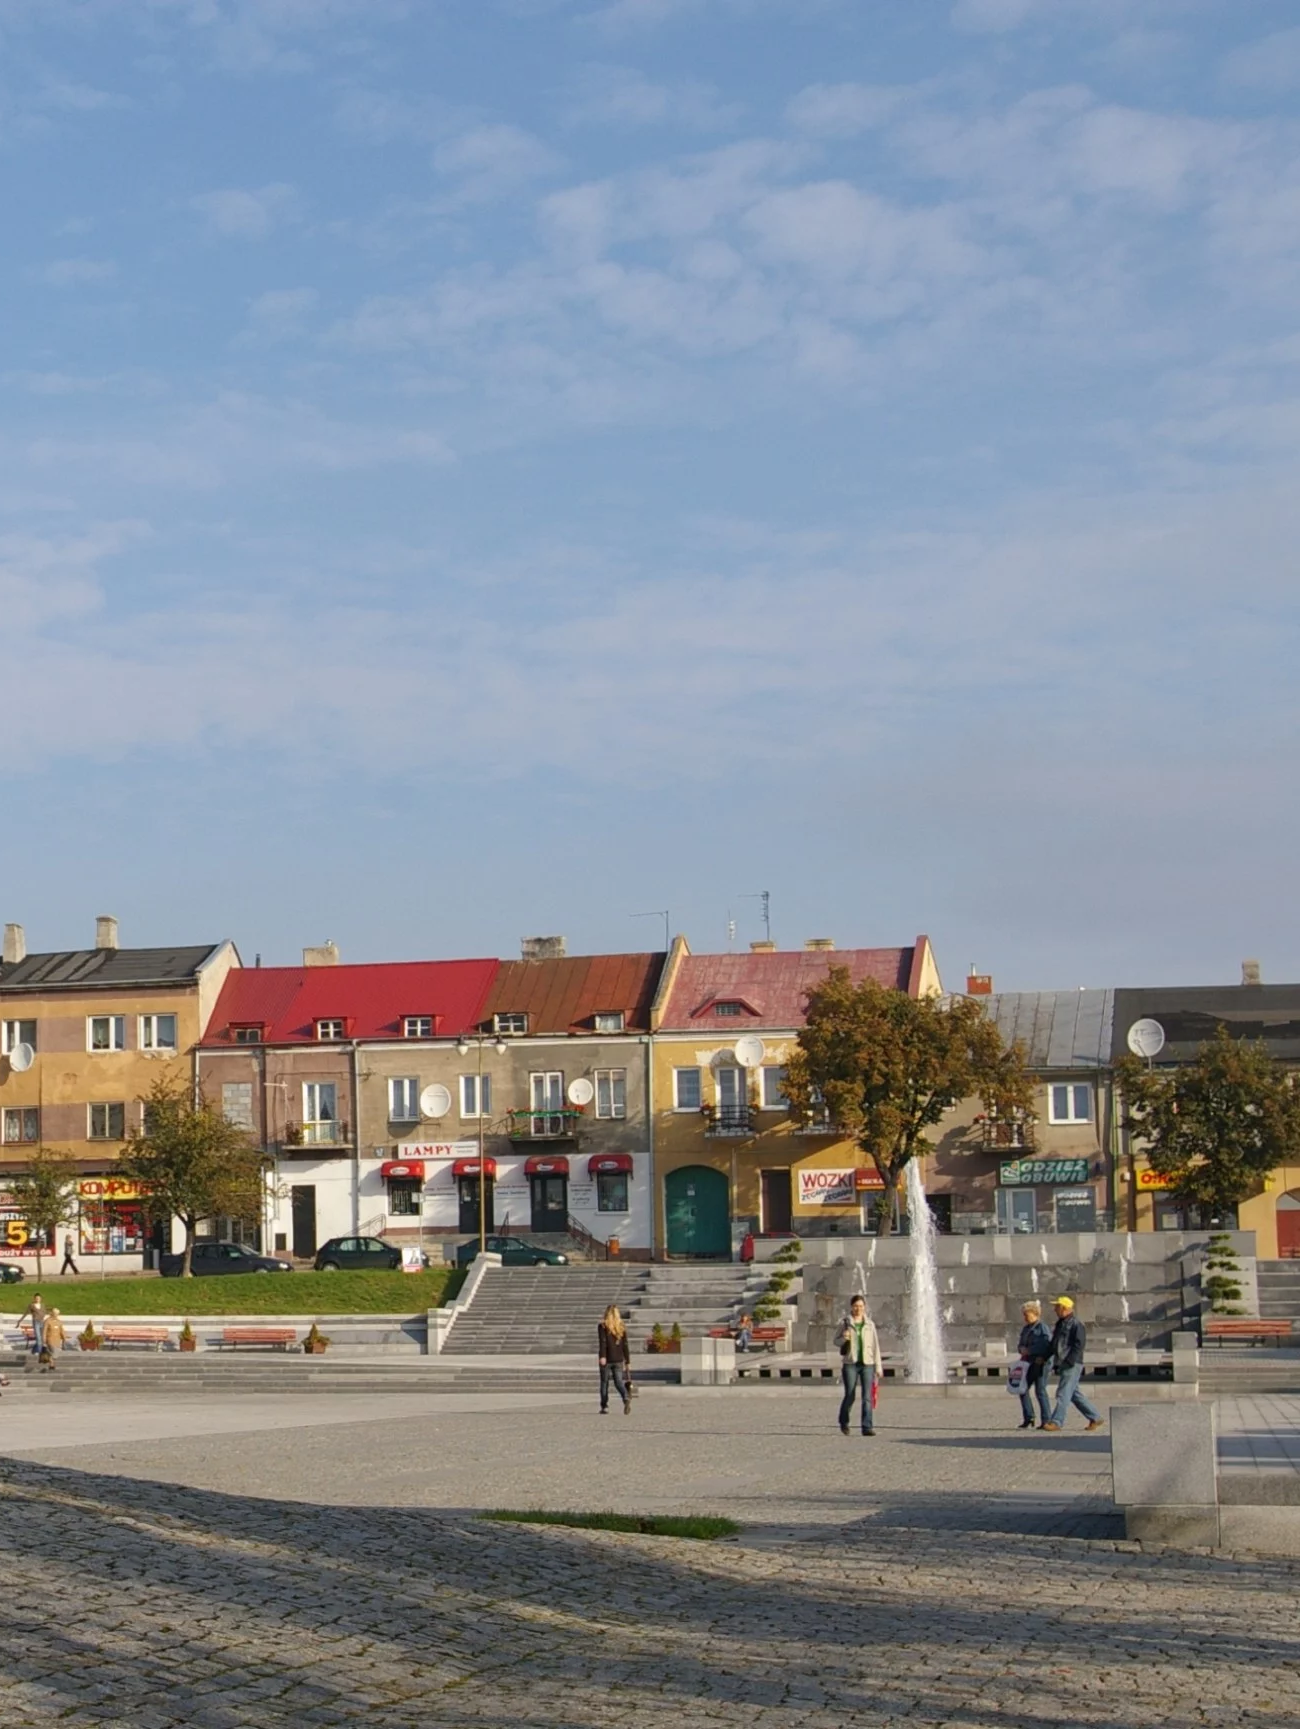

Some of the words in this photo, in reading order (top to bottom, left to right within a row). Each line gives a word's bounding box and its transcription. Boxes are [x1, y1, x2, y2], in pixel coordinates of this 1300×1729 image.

[403, 1144, 453, 1157] LAMPY
[1020, 1160, 1086, 1172] ODZIEŻ
[1020, 1171, 1087, 1184] OBUWIE
[6, 1220, 29, 1246] 5
[22, 1247, 53, 1257] WYÓR
